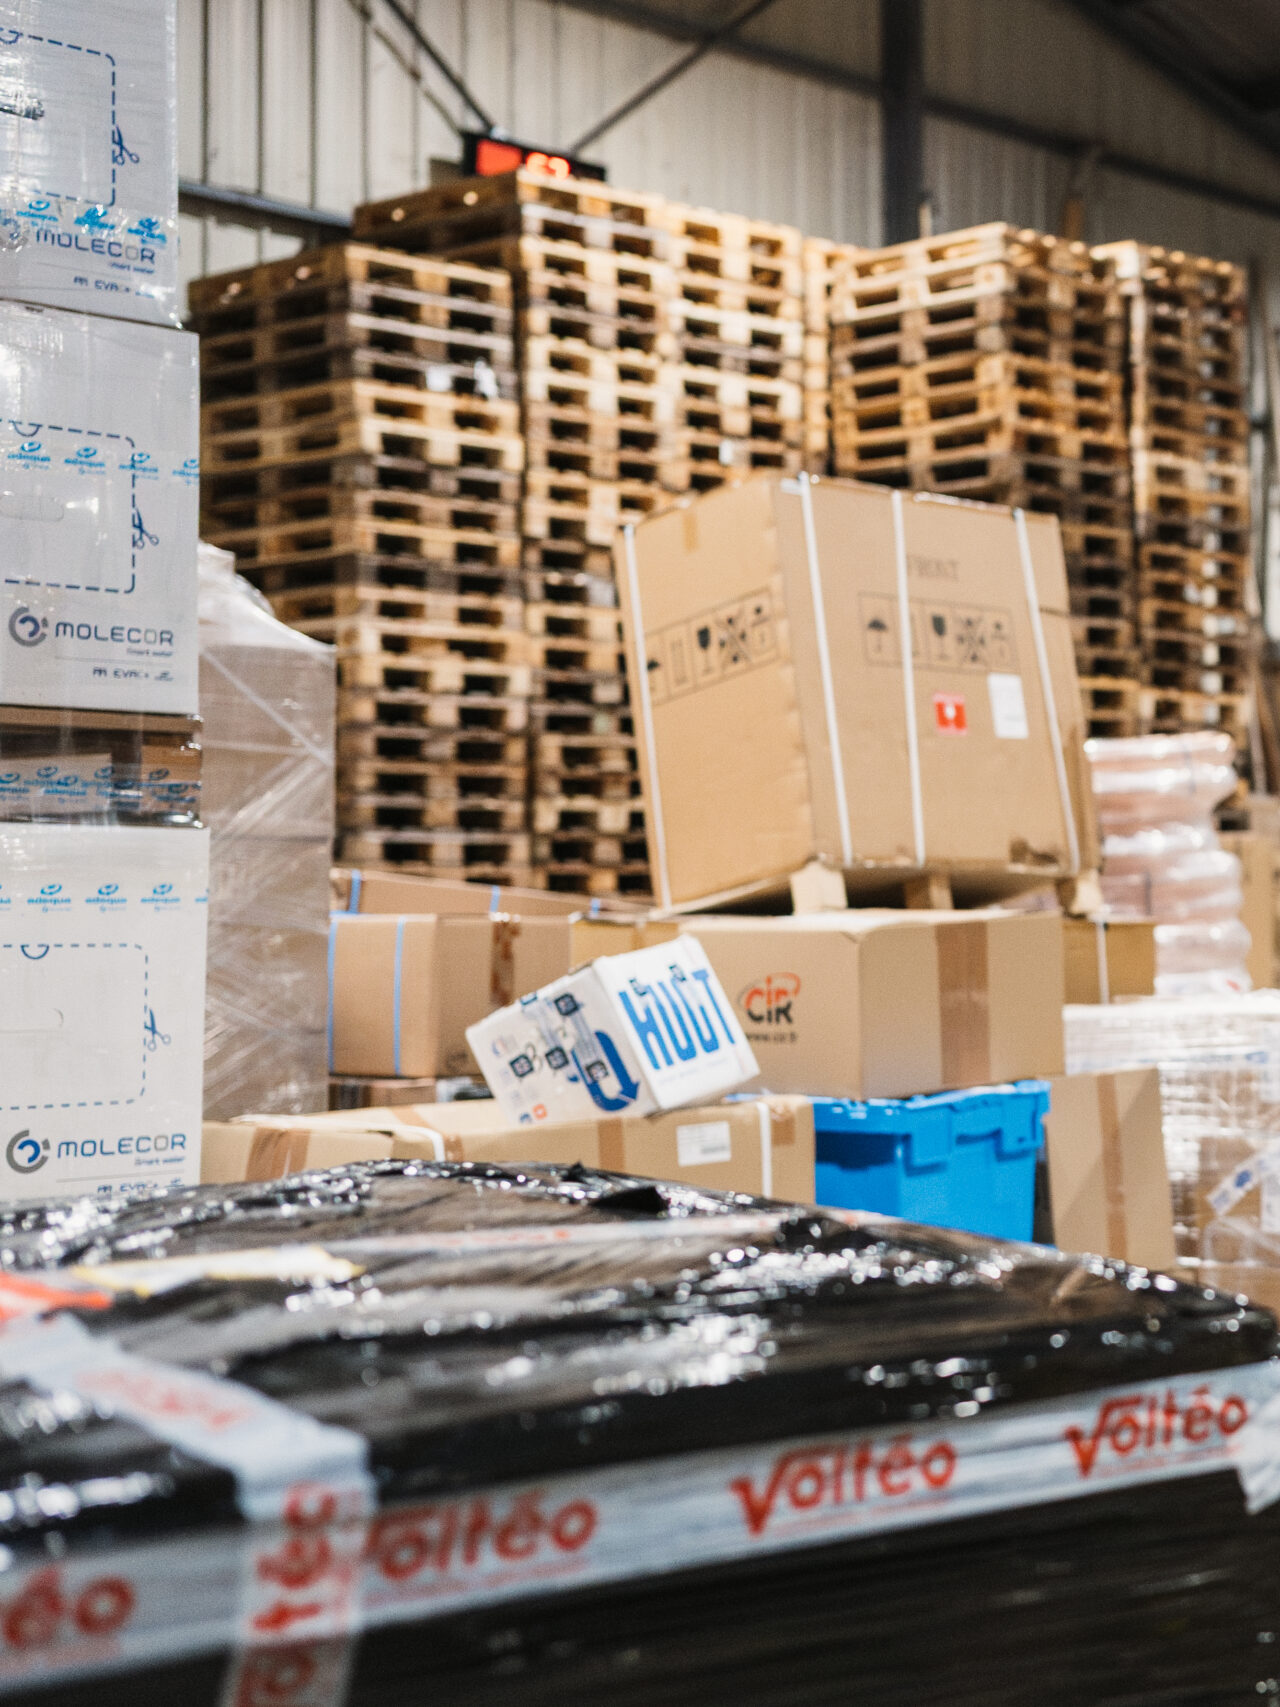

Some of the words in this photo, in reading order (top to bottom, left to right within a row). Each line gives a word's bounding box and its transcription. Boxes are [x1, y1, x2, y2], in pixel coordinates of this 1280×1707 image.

[36, 228, 156, 264] MOLECOR
[54, 620, 175, 647] MOLECOR
[57, 1132, 187, 1159] MOLECOR
[1063, 1384, 1250, 1479] Voltéo
[729, 1432, 958, 1538] Voltéo
